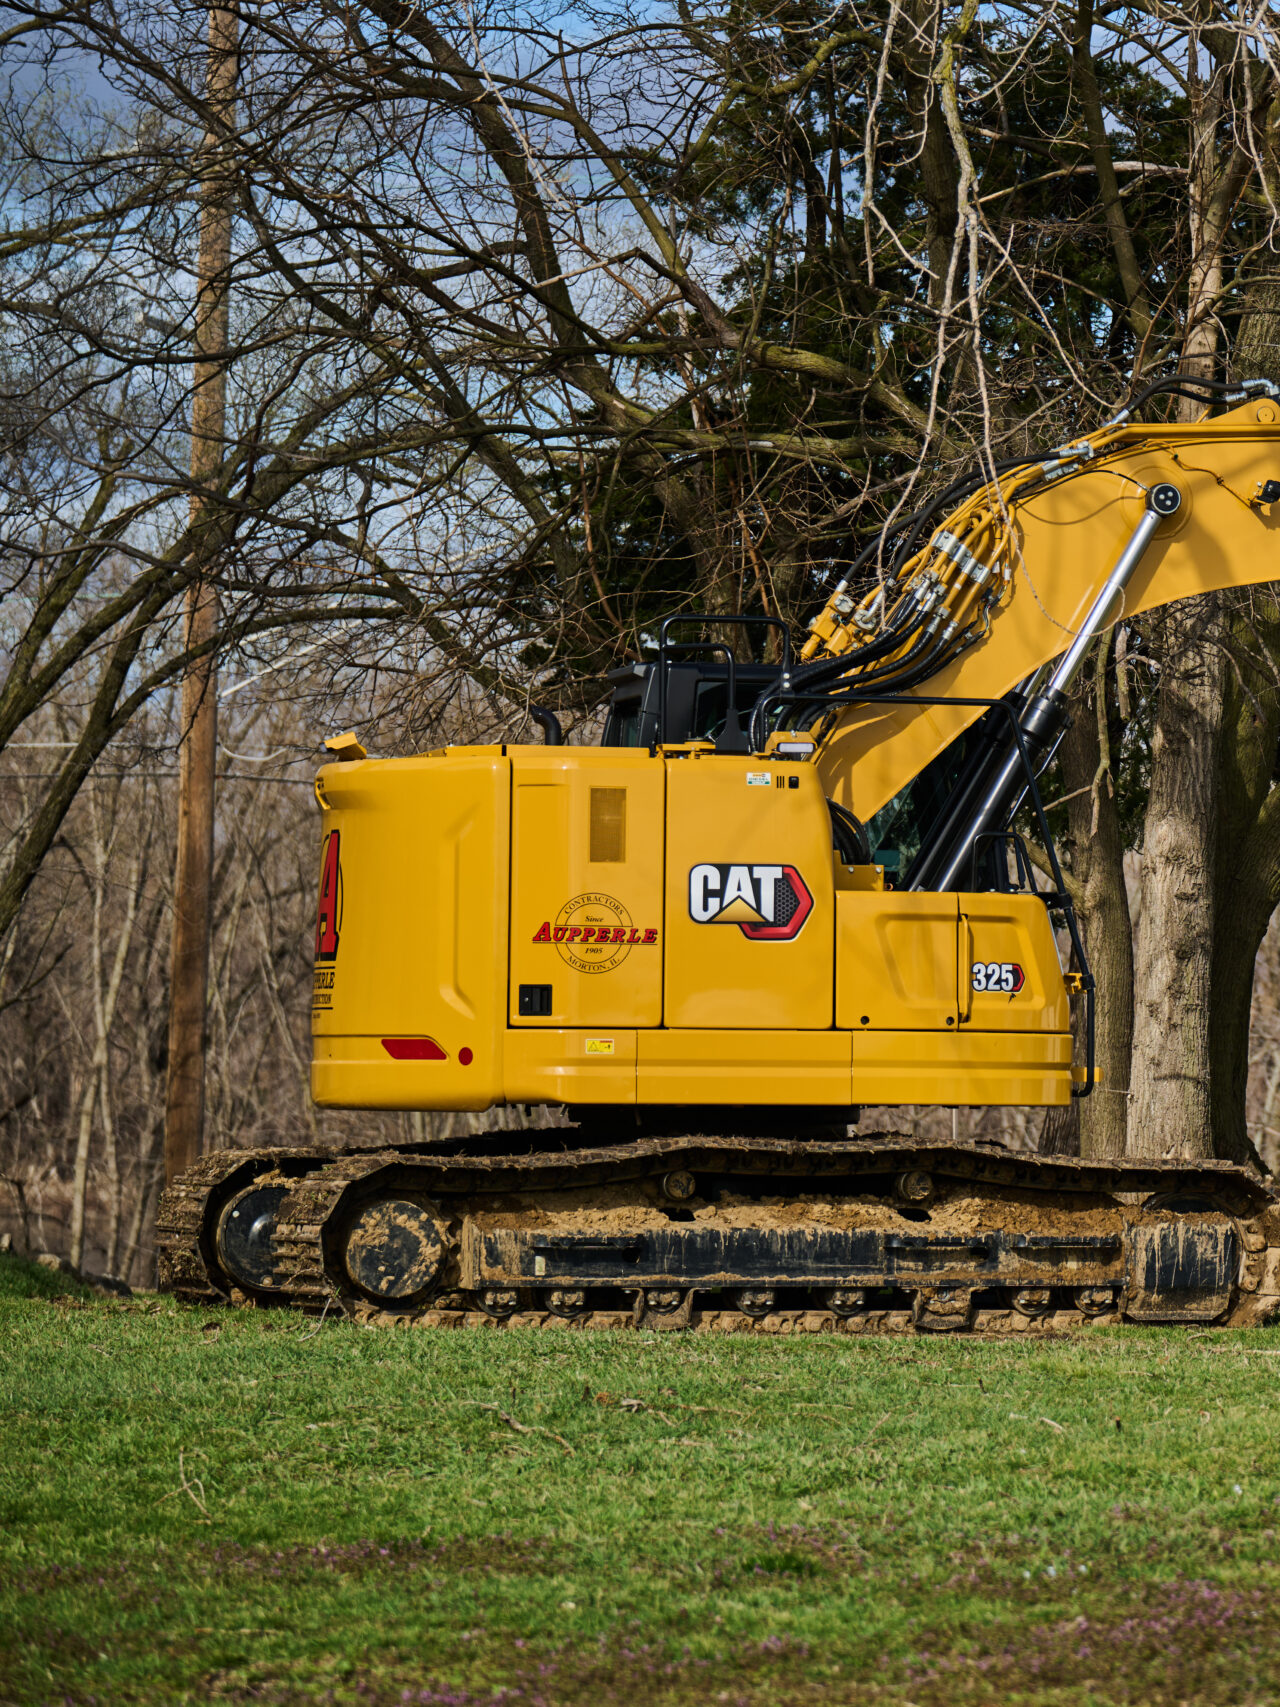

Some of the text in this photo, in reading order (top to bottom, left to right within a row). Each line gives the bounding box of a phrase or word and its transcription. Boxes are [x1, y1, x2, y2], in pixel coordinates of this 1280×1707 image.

[690, 864, 783, 922] CAT
[565, 895, 624, 915] CONTRACTORS
[585, 915, 604, 923] Since
[532, 921, 658, 943] AUPPERLE
[567, 955, 620, 972] MORTON, IL
[972, 962, 1014, 991] 325
